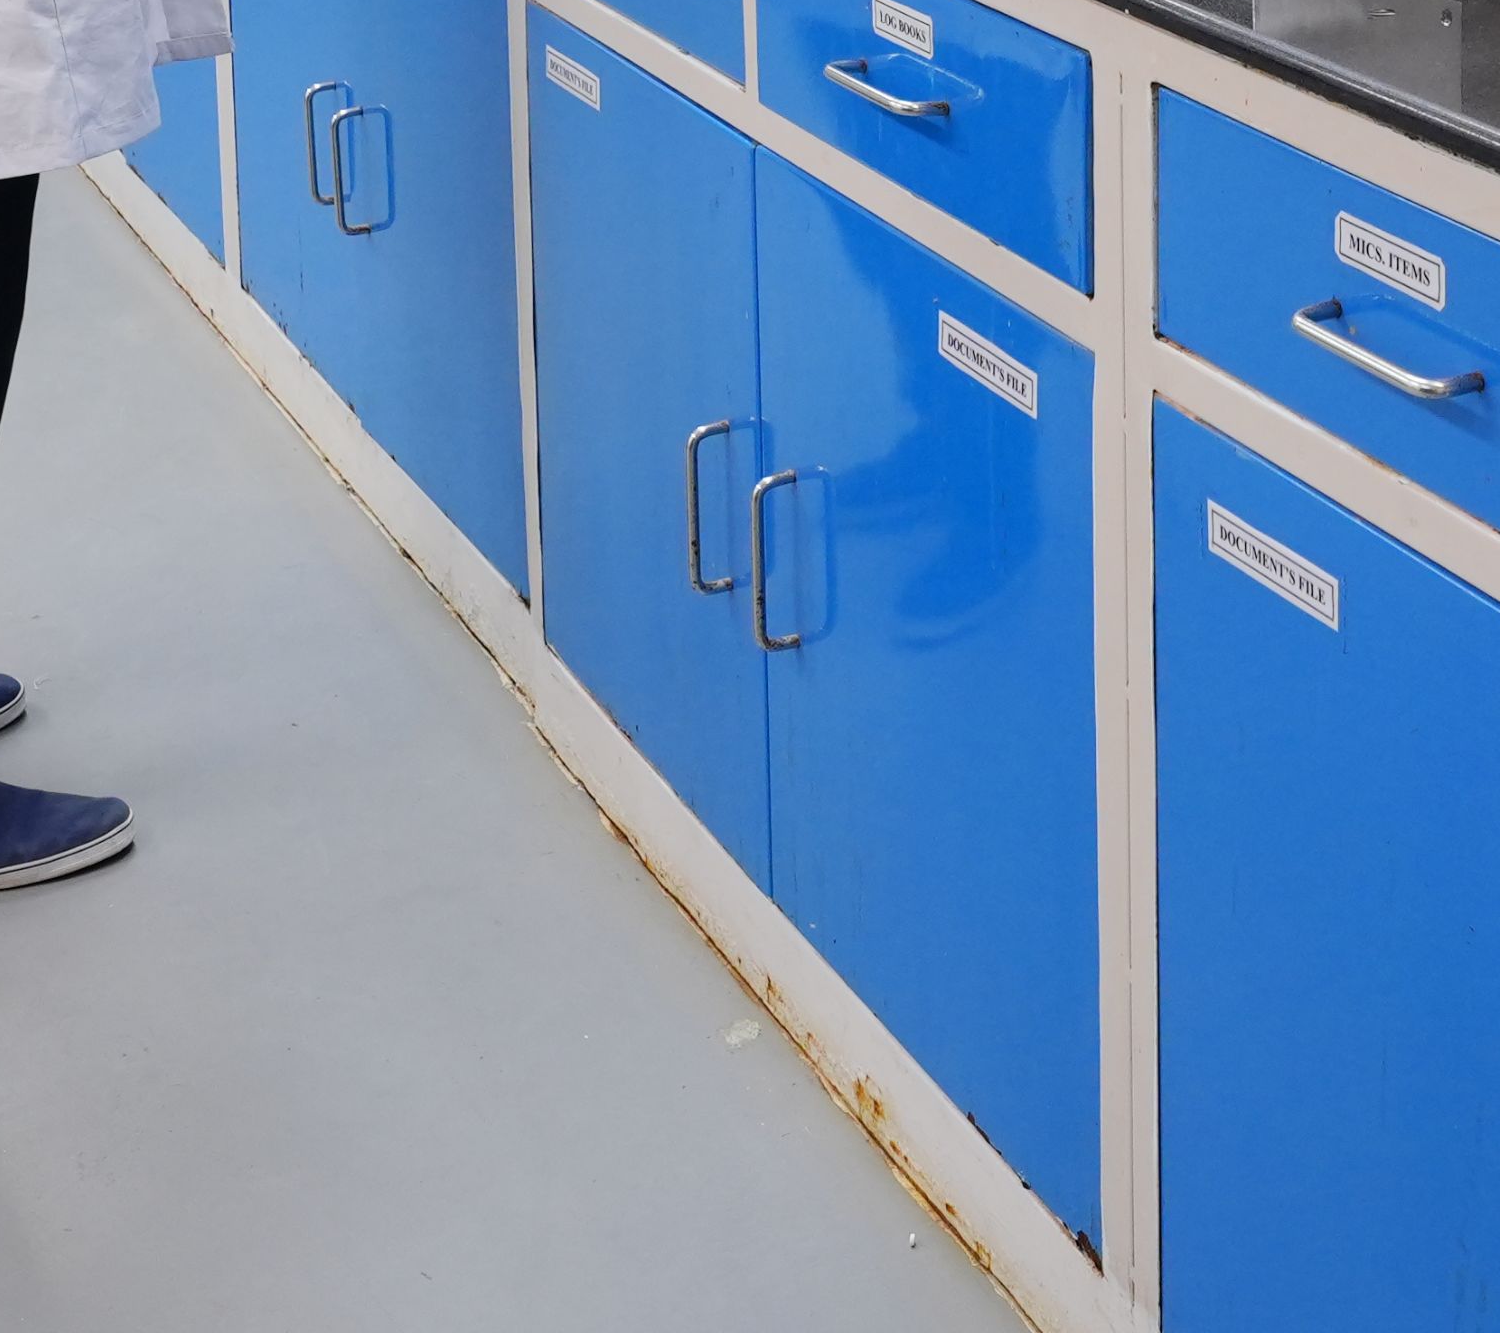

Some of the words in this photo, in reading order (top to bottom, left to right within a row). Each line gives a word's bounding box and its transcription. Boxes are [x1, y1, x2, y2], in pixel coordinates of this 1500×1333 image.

[879, 9, 897, 30] LOG
[898, 19, 926, 44] BOOKS
[1349, 233, 1385, 265] MICS.
[1389, 252, 1431, 287] ITEMS
[947, 333, 1005, 382] DOCUMENT'S
[1006, 373, 1027, 398] FILE
[1220, 525, 1296, 586] DOCUMENT'S
[1298, 575, 1326, 606] FILE
